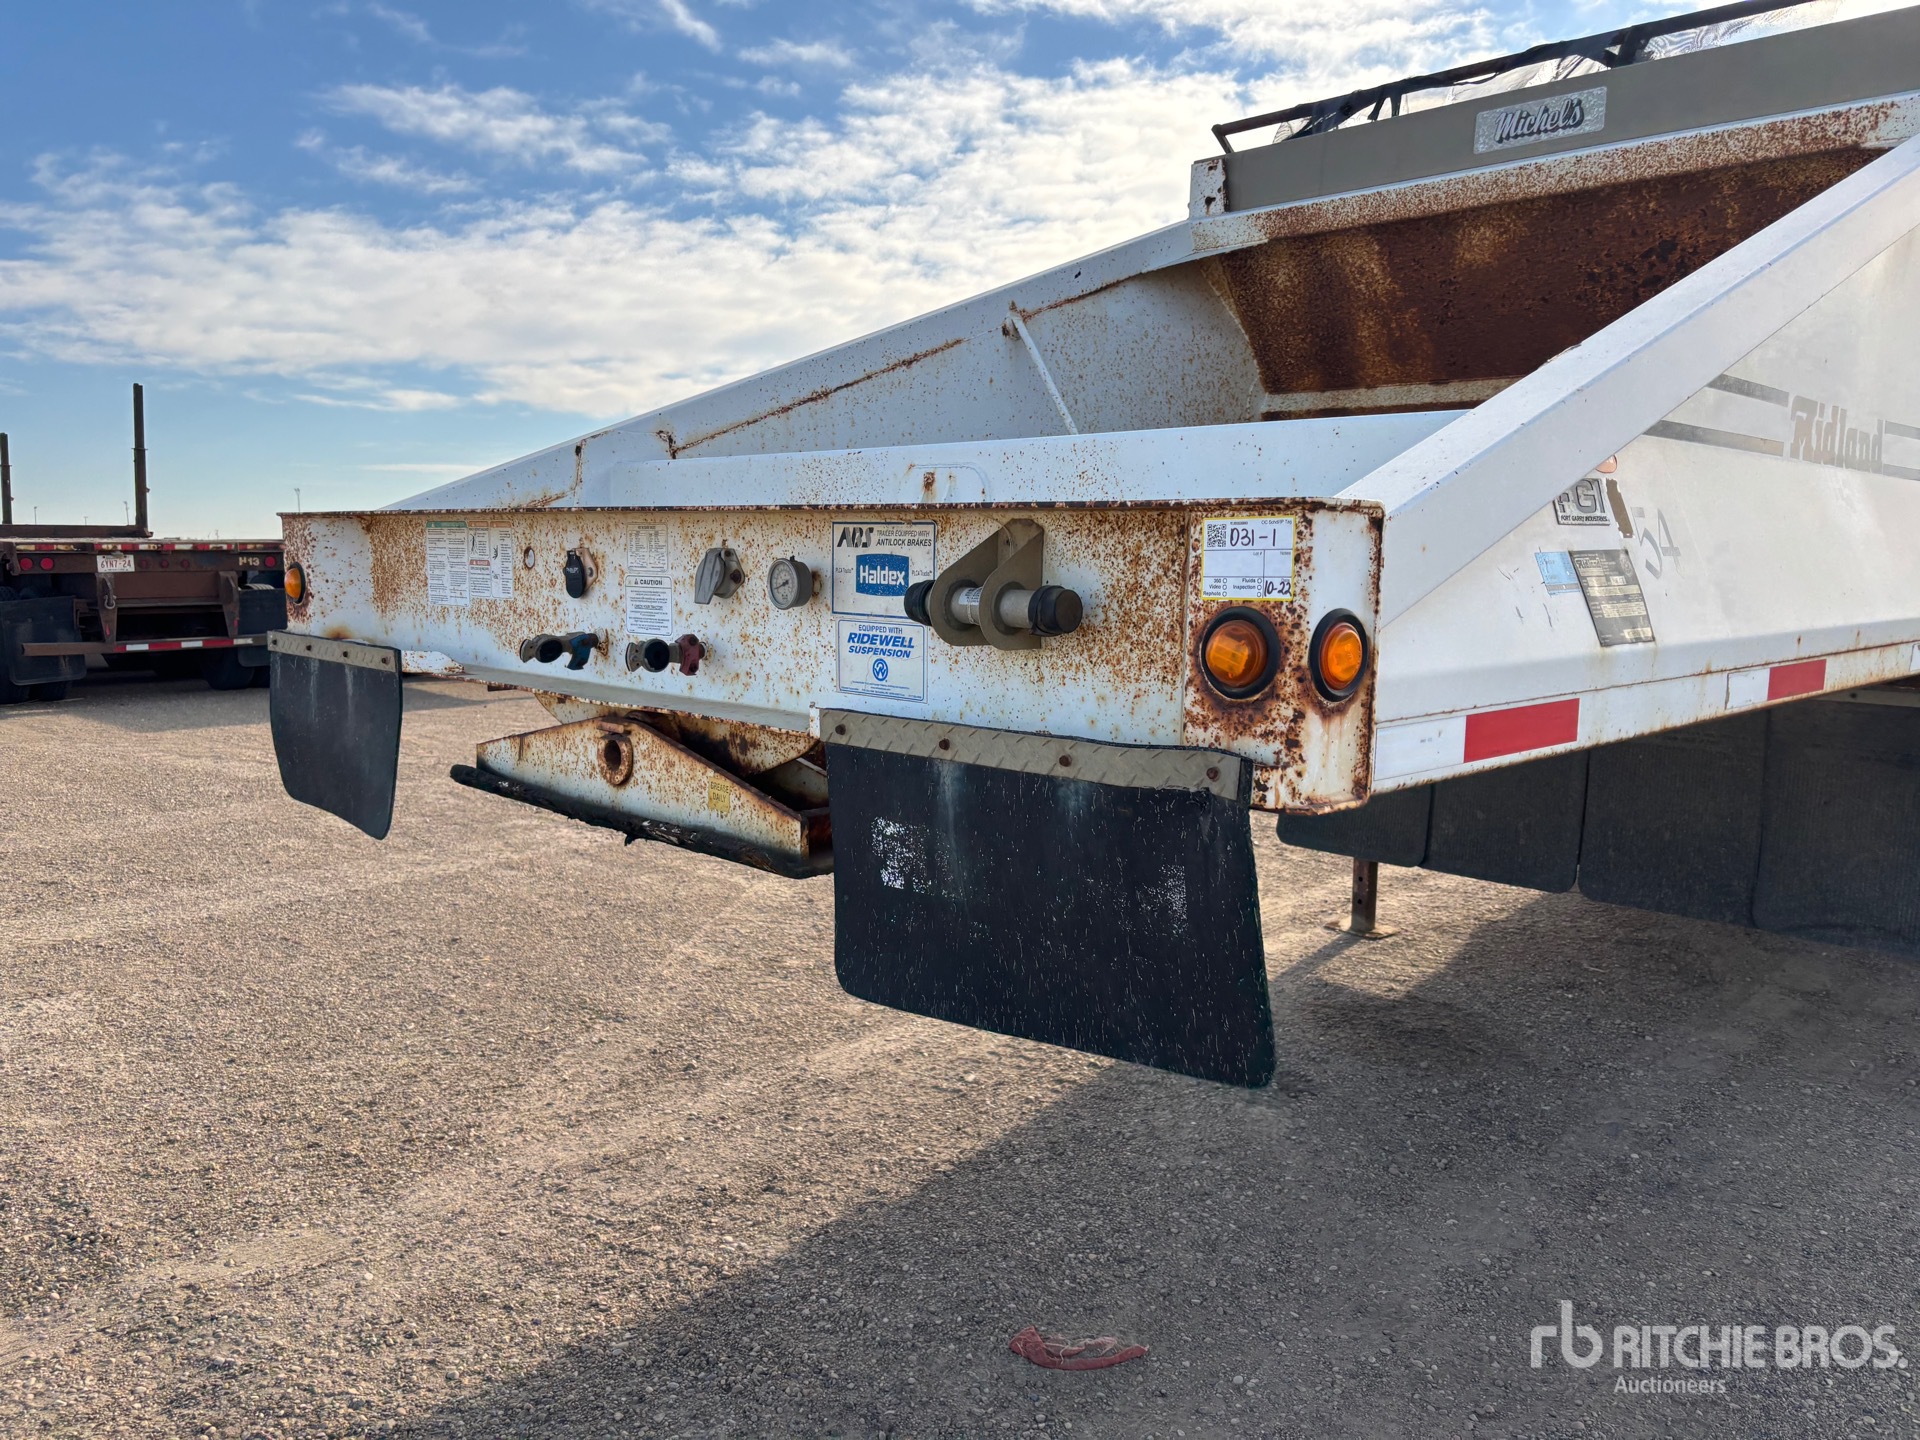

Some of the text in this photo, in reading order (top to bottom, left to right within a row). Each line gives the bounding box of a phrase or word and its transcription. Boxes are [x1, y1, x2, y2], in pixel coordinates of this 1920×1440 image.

[1493, 97, 1585, 144] Michel's
[836, 526, 875, 548] ABS
[876, 529, 895, 537] TRAILER
[895, 529, 917, 538] EQUIPPED
[875, 538, 932, 547] ANTILOCK BRAKES
[860, 565, 905, 586] Haldex
[858, 624, 887, 634] EQUIPPED
[847, 632, 915, 649] RIDEWELL
[848, 645, 911, 658] SUSPENSION
[710, 781, 729, 793] GREASE
[712, 791, 726, 802] DAILY
